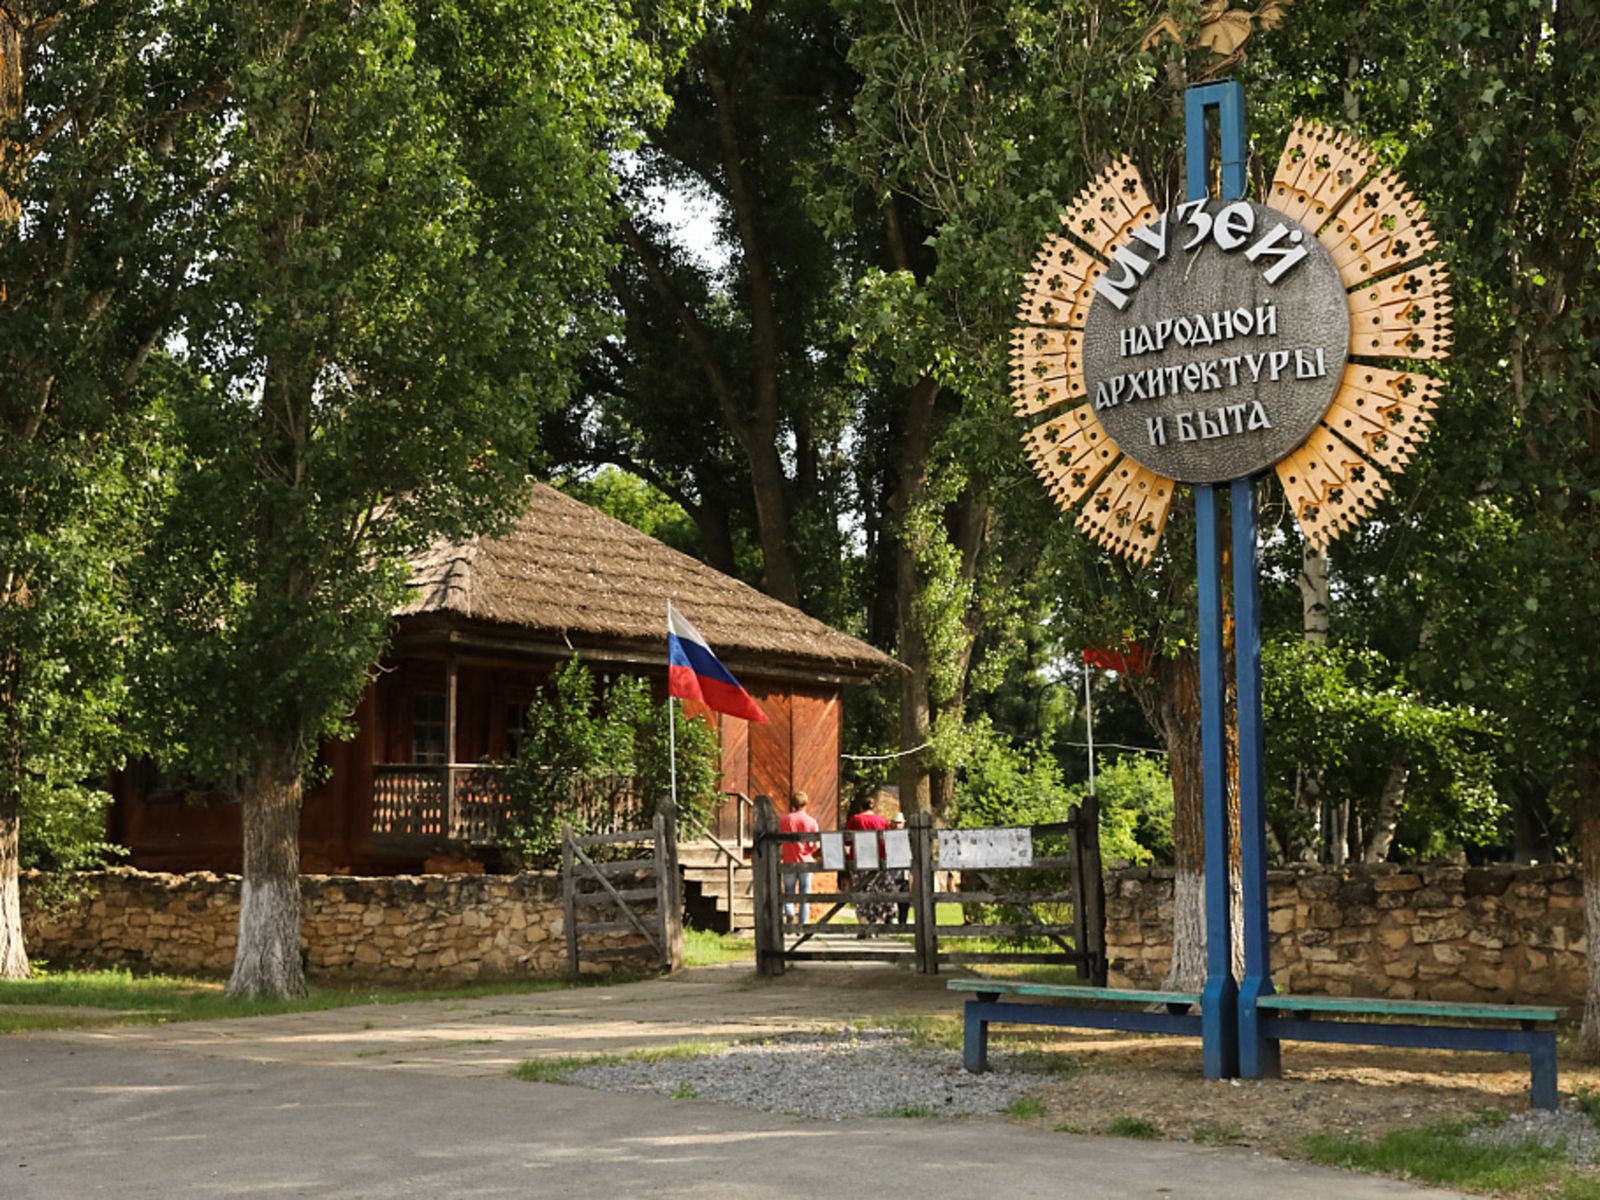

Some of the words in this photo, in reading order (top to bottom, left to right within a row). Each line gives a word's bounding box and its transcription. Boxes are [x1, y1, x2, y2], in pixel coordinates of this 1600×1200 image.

[1120, 299, 1277, 357] НАРОДНОЙ
[1095, 348, 1327, 411] АРХИТЕКТУРЫ
[1146, 416, 1166, 445] И
[1177, 401, 1272, 442] БЫТА
